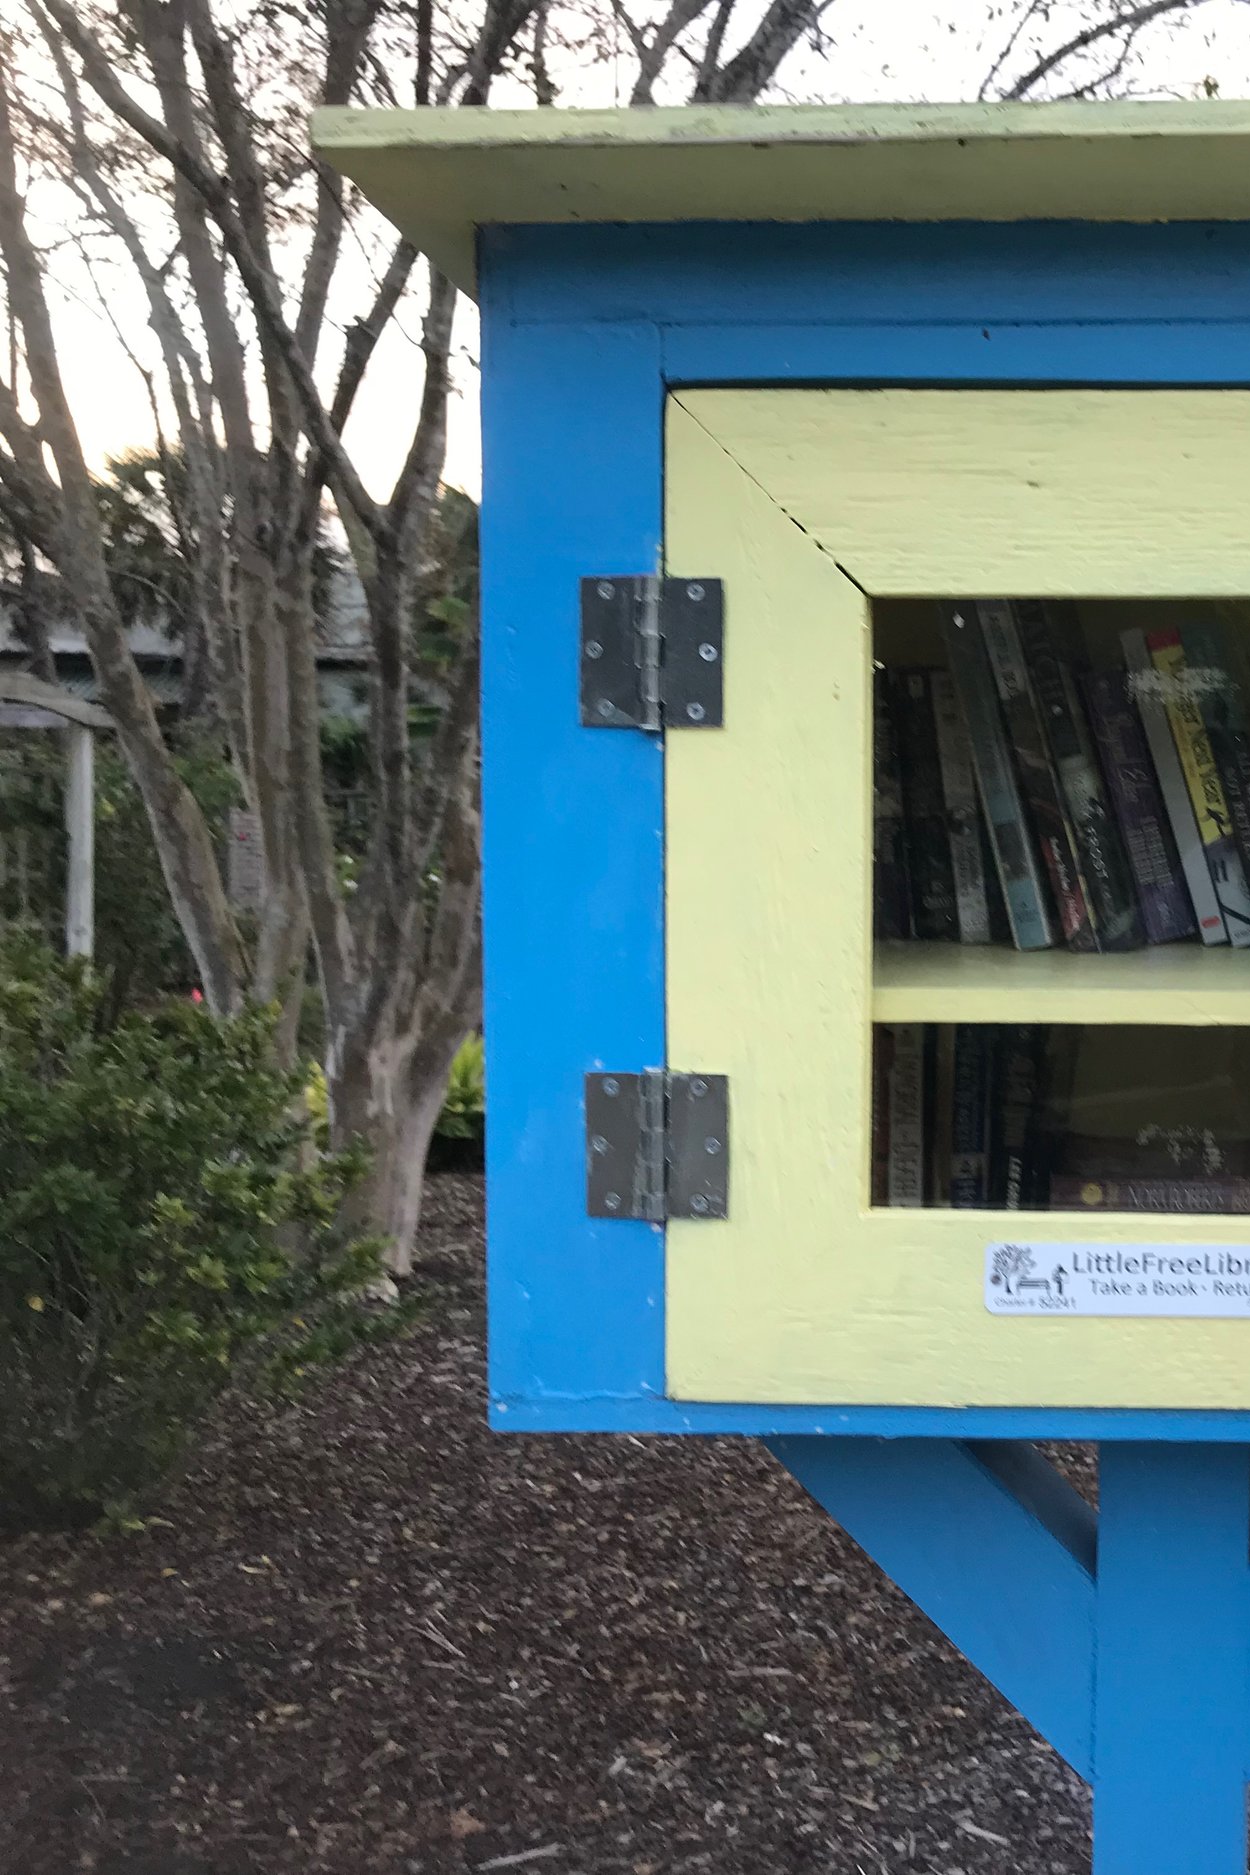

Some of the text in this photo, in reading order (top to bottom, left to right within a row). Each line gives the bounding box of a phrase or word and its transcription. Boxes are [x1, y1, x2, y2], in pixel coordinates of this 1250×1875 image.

[1090, 1278, 1132, 1296] Take
[1136, 1282, 1148, 1296] a
[1153, 1279, 1198, 1297] Book
